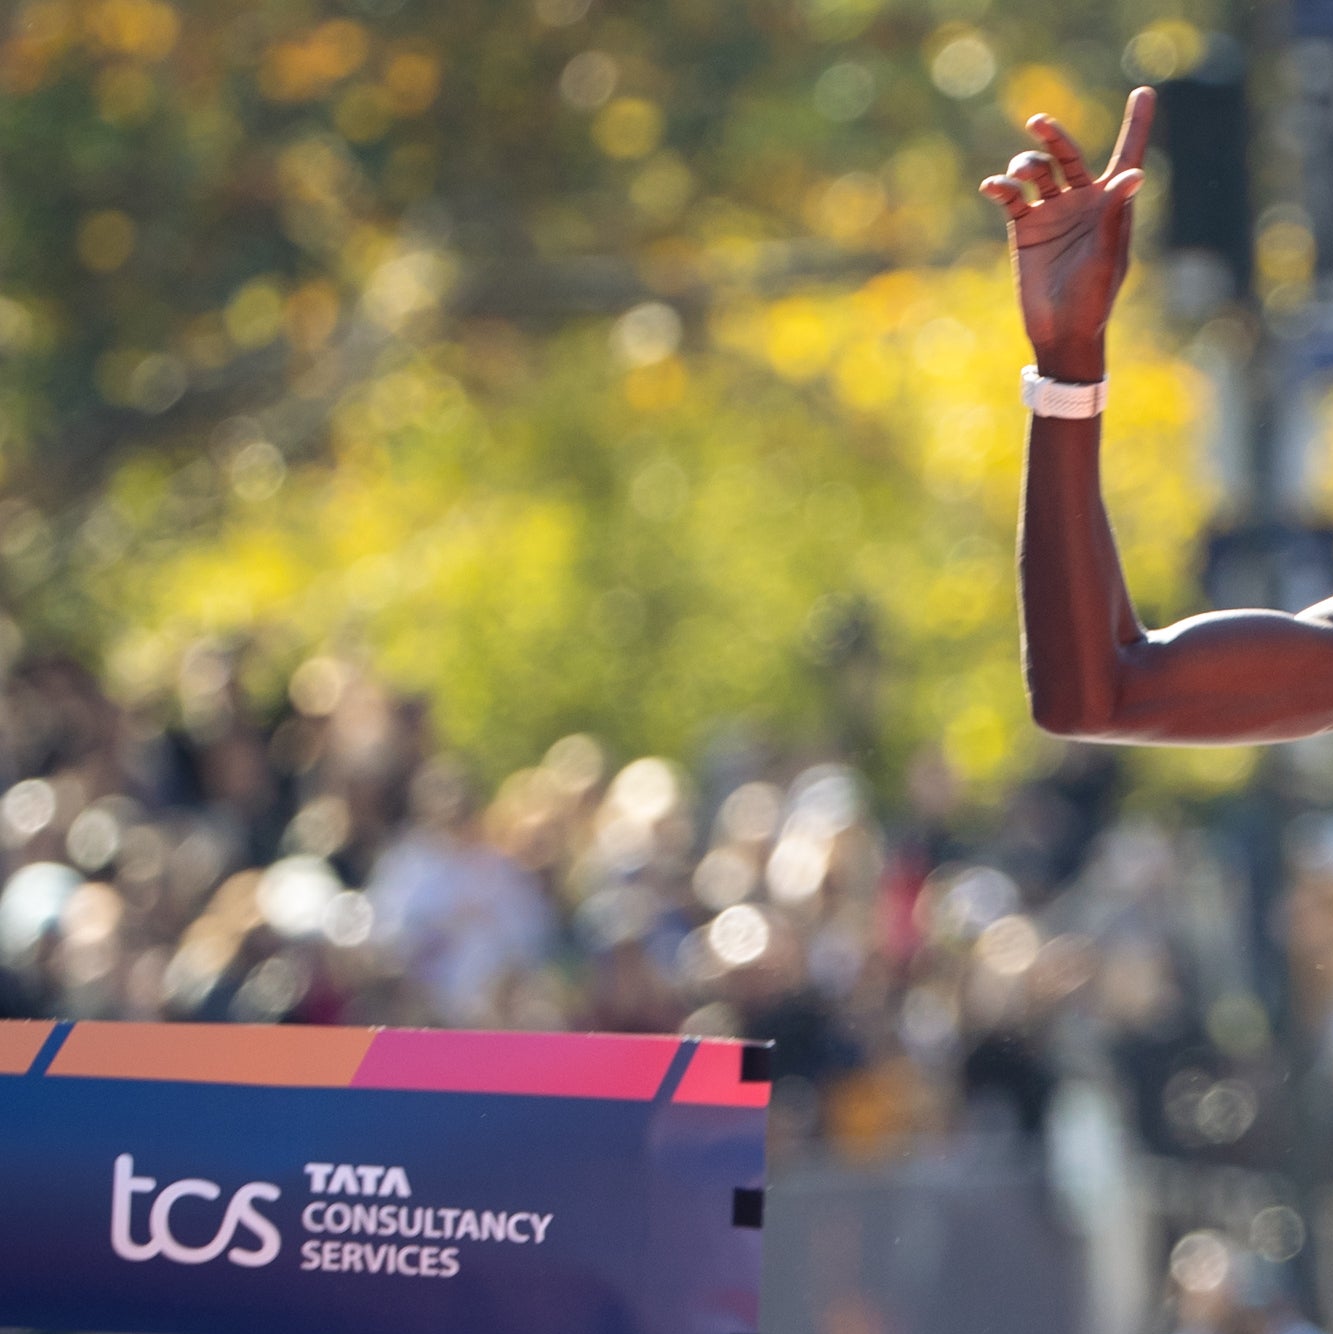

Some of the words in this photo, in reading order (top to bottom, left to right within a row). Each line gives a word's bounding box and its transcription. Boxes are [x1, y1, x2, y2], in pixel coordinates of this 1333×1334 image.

[304, 1162, 411, 1199] TATA
[110, 1153, 281, 1267] tcs
[301, 1202, 554, 1245] CONSULTANCY
[301, 1241, 461, 1278] SERVICES
